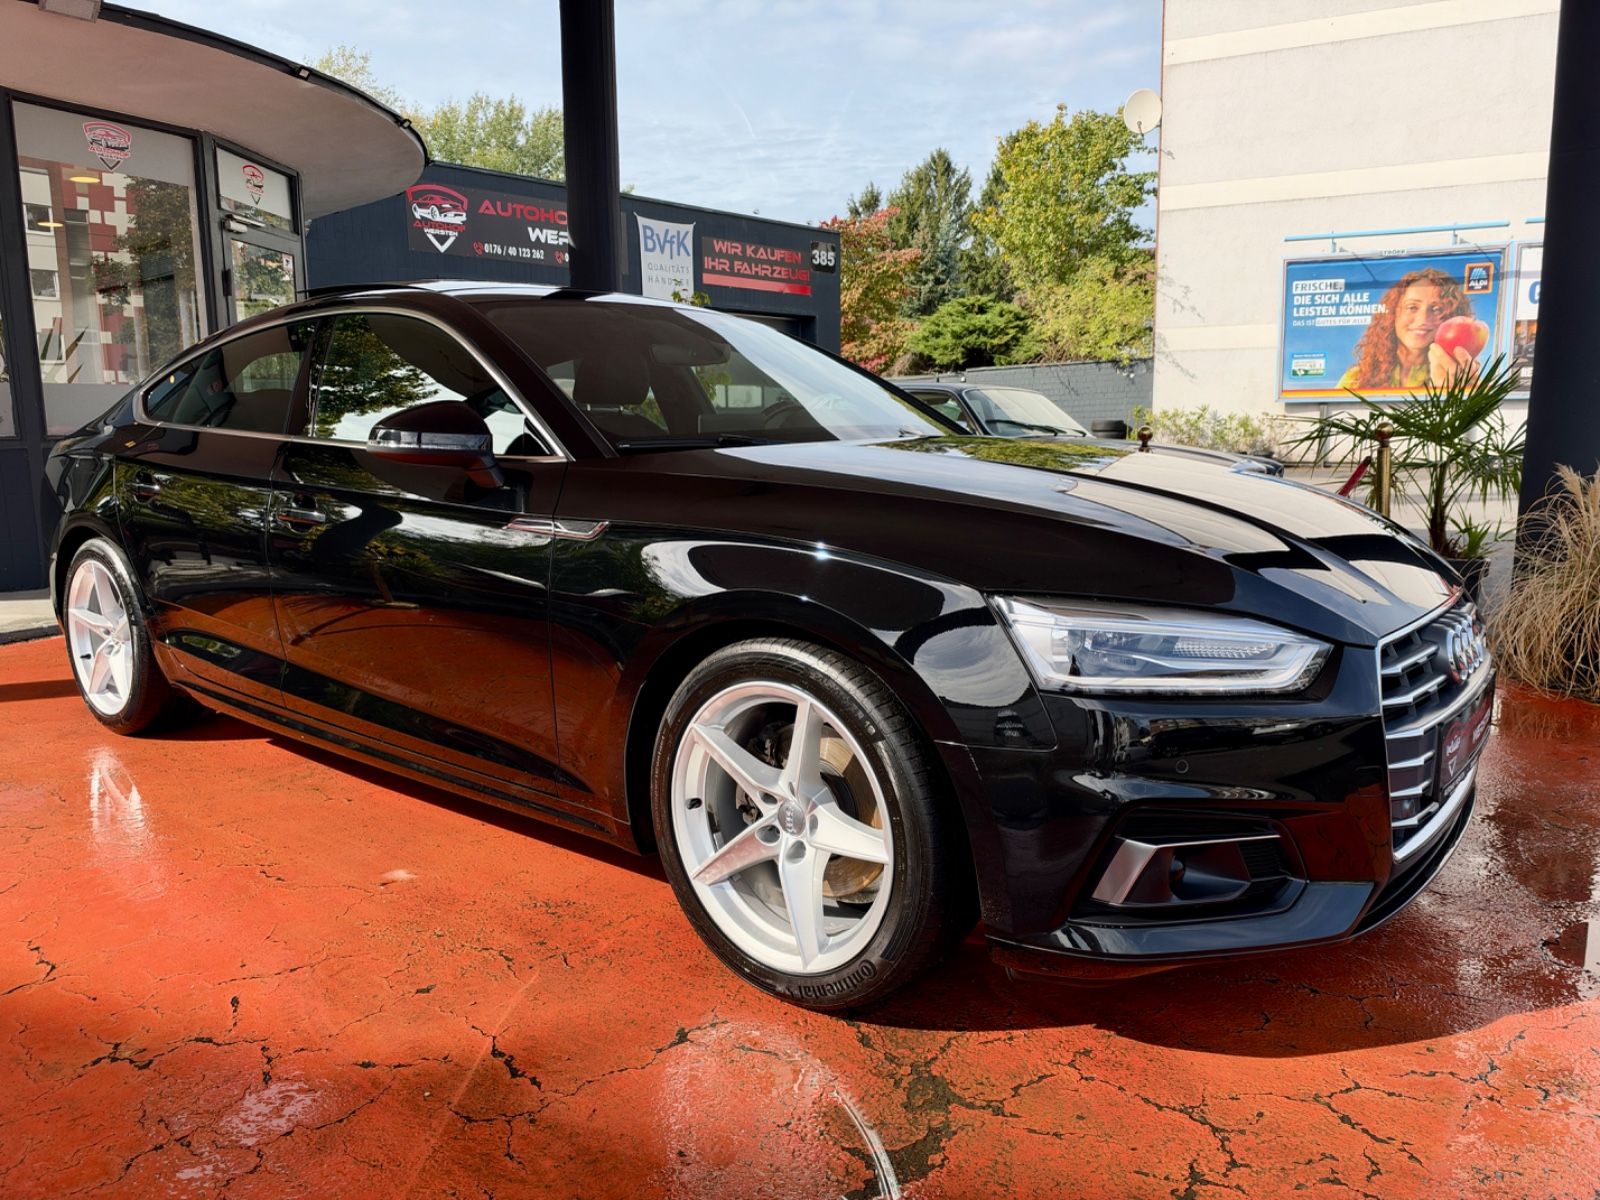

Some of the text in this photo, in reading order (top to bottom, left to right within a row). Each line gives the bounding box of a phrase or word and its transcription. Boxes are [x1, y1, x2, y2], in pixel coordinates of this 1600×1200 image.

[478, 200, 568, 225] AUTOHO
[412, 220, 466, 232] AUTOHOF
[423, 227, 459, 237] WERSTEN
[527, 226, 569, 245] WER
[484, 243, 502, 256] 0176
[508, 245, 518, 257] 40
[519, 247, 531, 259] 123
[532, 249, 545, 260] 262
[713, 239, 802, 264] WIR KAUFEN
[811, 250, 836, 266] 385
[704, 256, 731, 273] IHR
[1294, 281, 1343, 292] FRISCHE.
[1293, 292, 1370, 305] DIE SICH ALLE
[1293, 302, 1389, 317] LEISTEN KÖNNEN.
[799, 959, 877, 999] Continental
